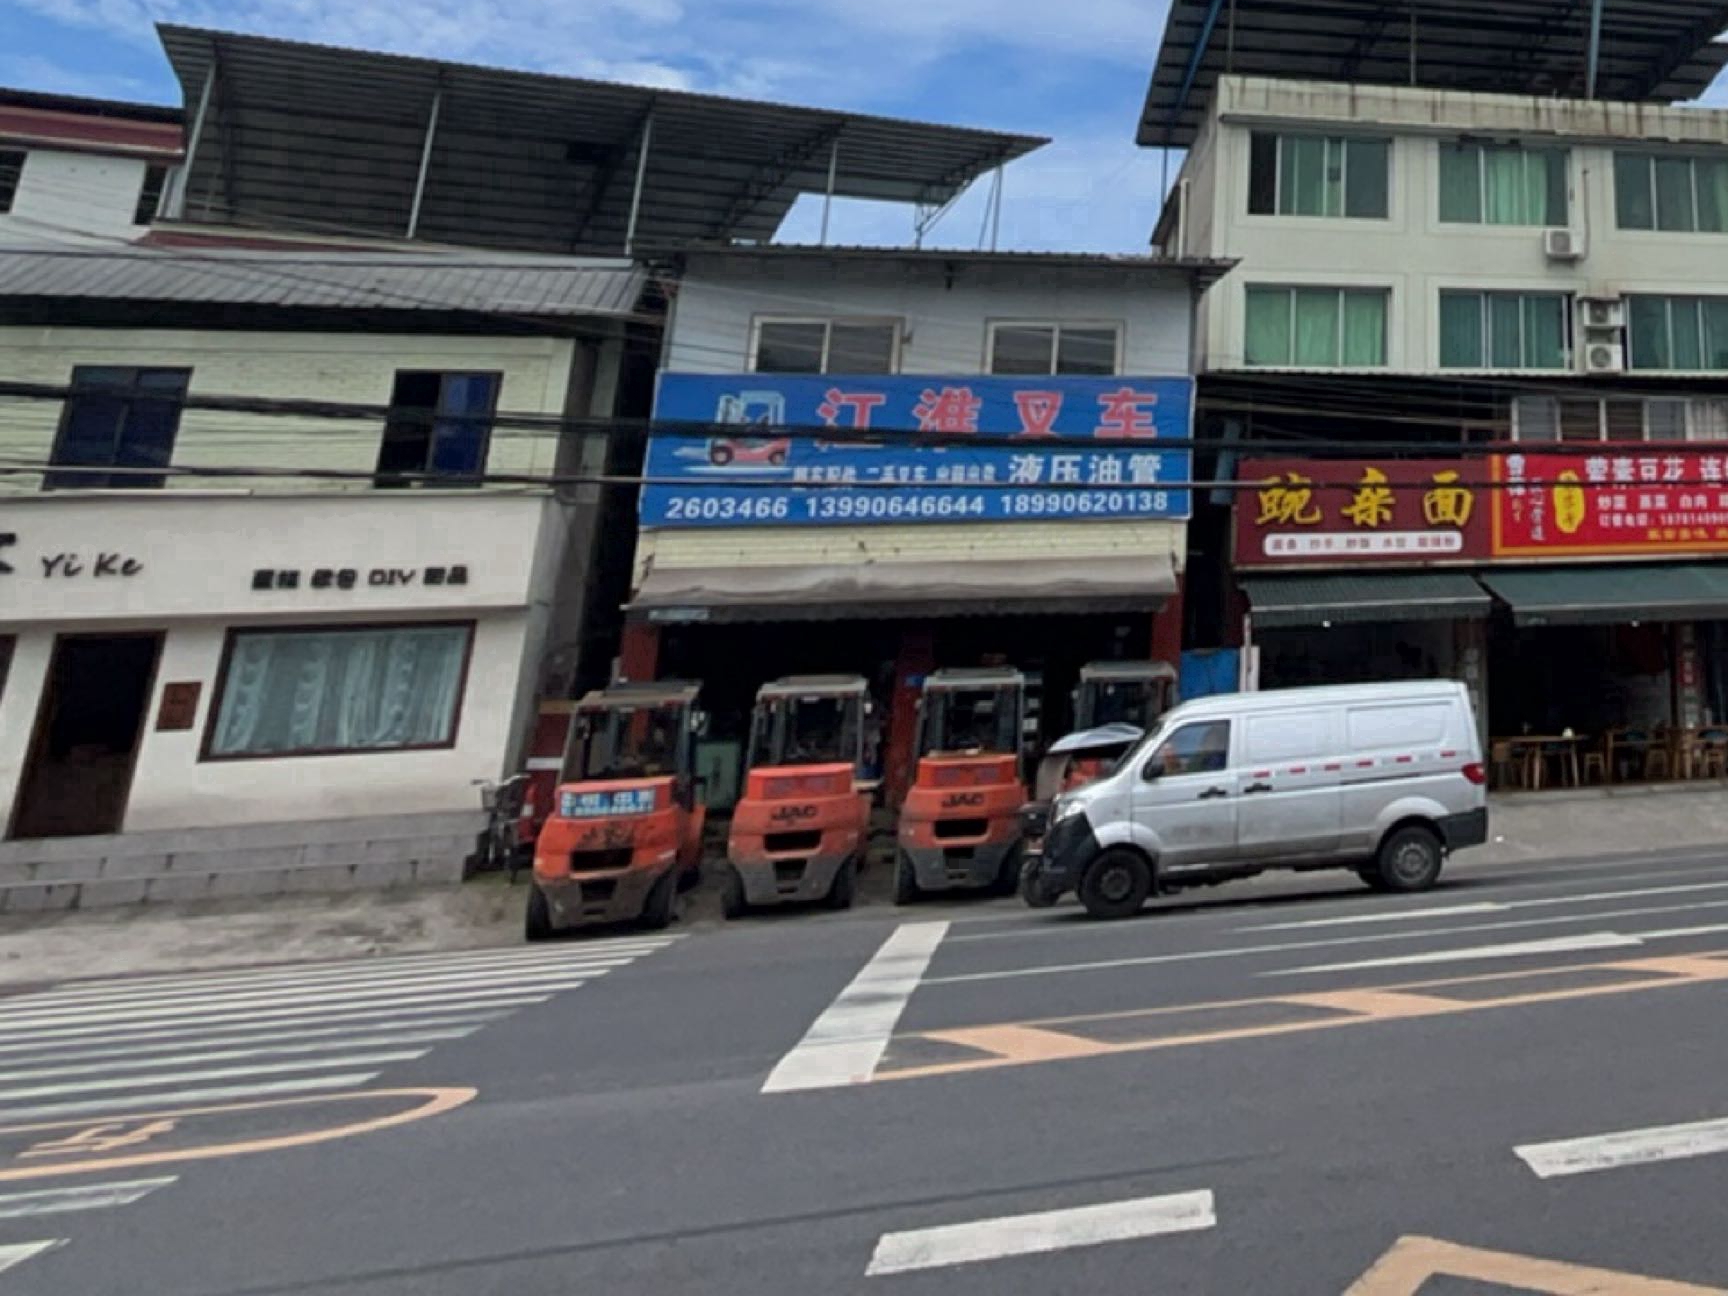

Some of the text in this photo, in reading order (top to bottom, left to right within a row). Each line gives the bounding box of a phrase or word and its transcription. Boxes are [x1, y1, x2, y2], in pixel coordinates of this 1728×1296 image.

[816, 387, 1158, 452] 江淮叉车
[1007, 453, 1162, 485] 液压油管
[664, 490, 1169, 521] 2603466 13990646644 18990620138
[41, 552, 83, 579] Yi
[93, 551, 144, 579] Ke
[367, 567, 417, 586] DIY
